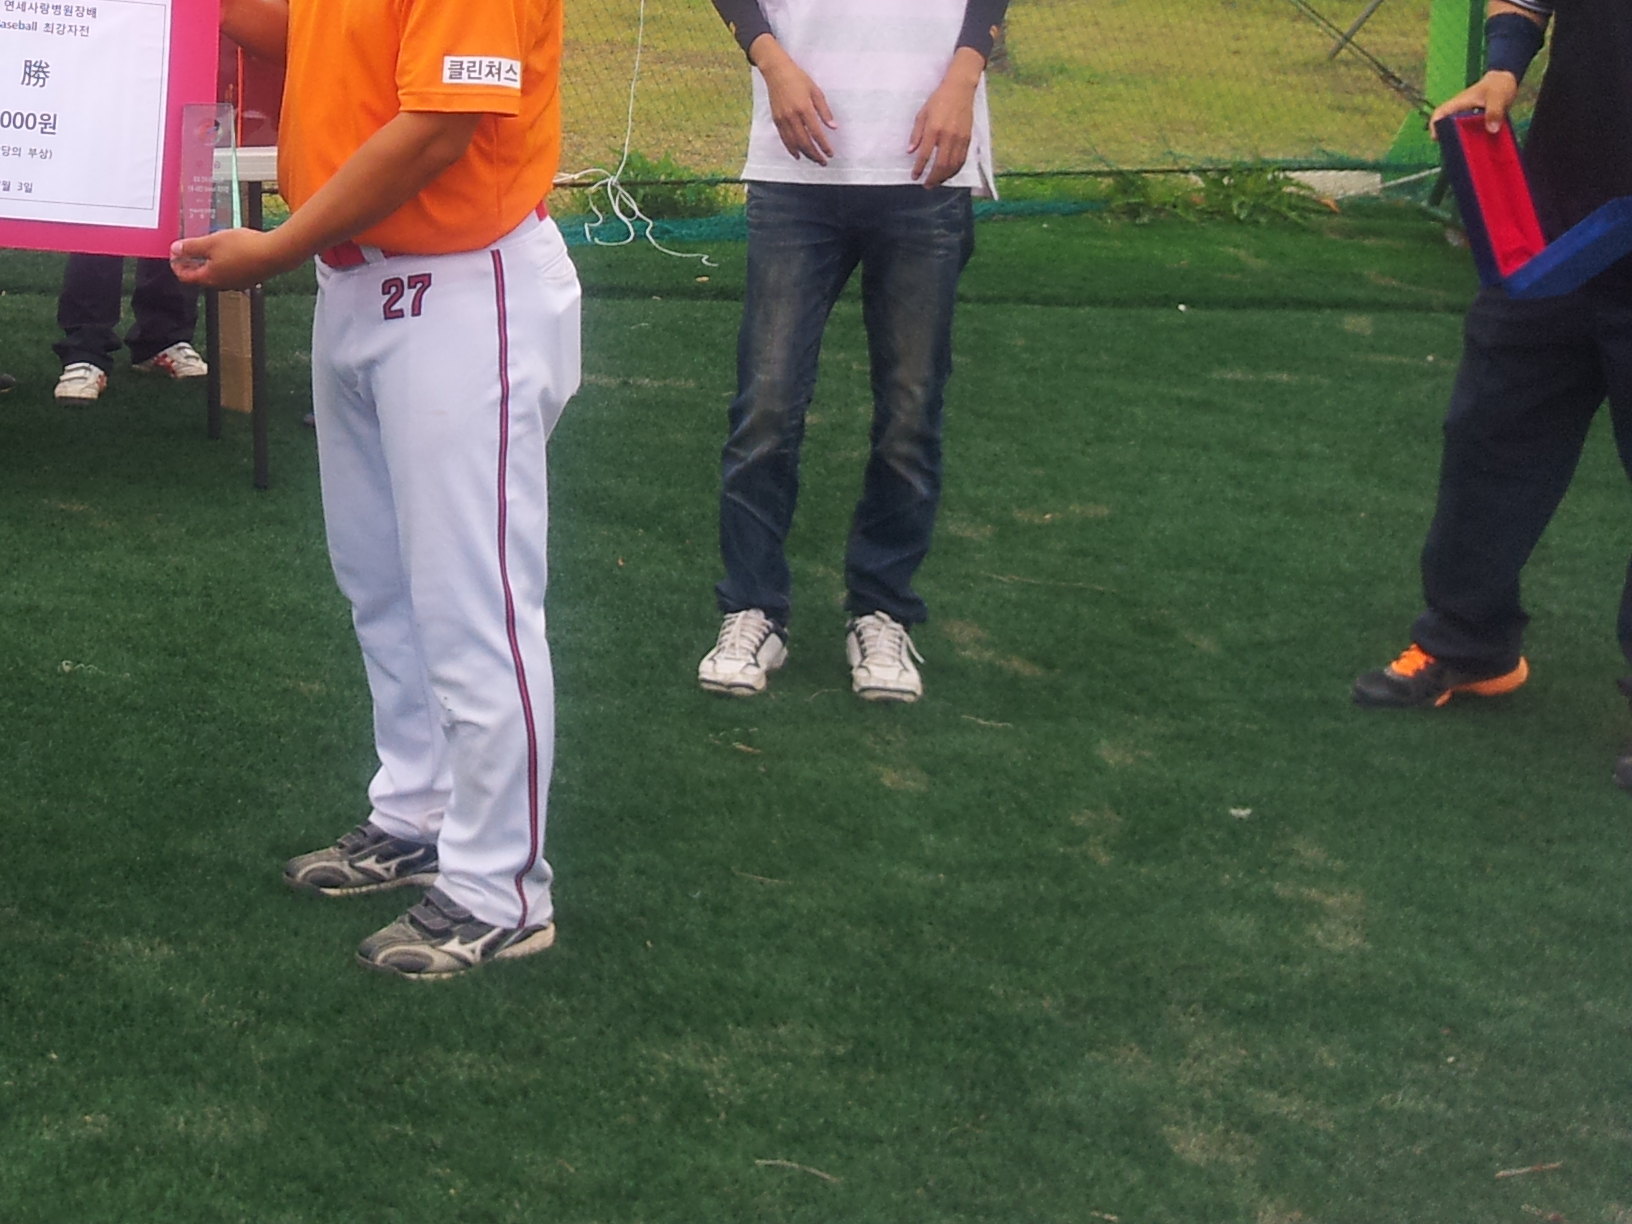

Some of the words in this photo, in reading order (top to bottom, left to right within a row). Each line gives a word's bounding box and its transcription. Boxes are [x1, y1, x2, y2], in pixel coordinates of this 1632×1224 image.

[4, 0, 98, 19] 연세사랑병원장배
[43, 22, 90, 37] 최강자전
[27, 147, 53, 160] 부상)
[17, 181, 33, 194] 3일
[381, 272, 432, 320] 27
